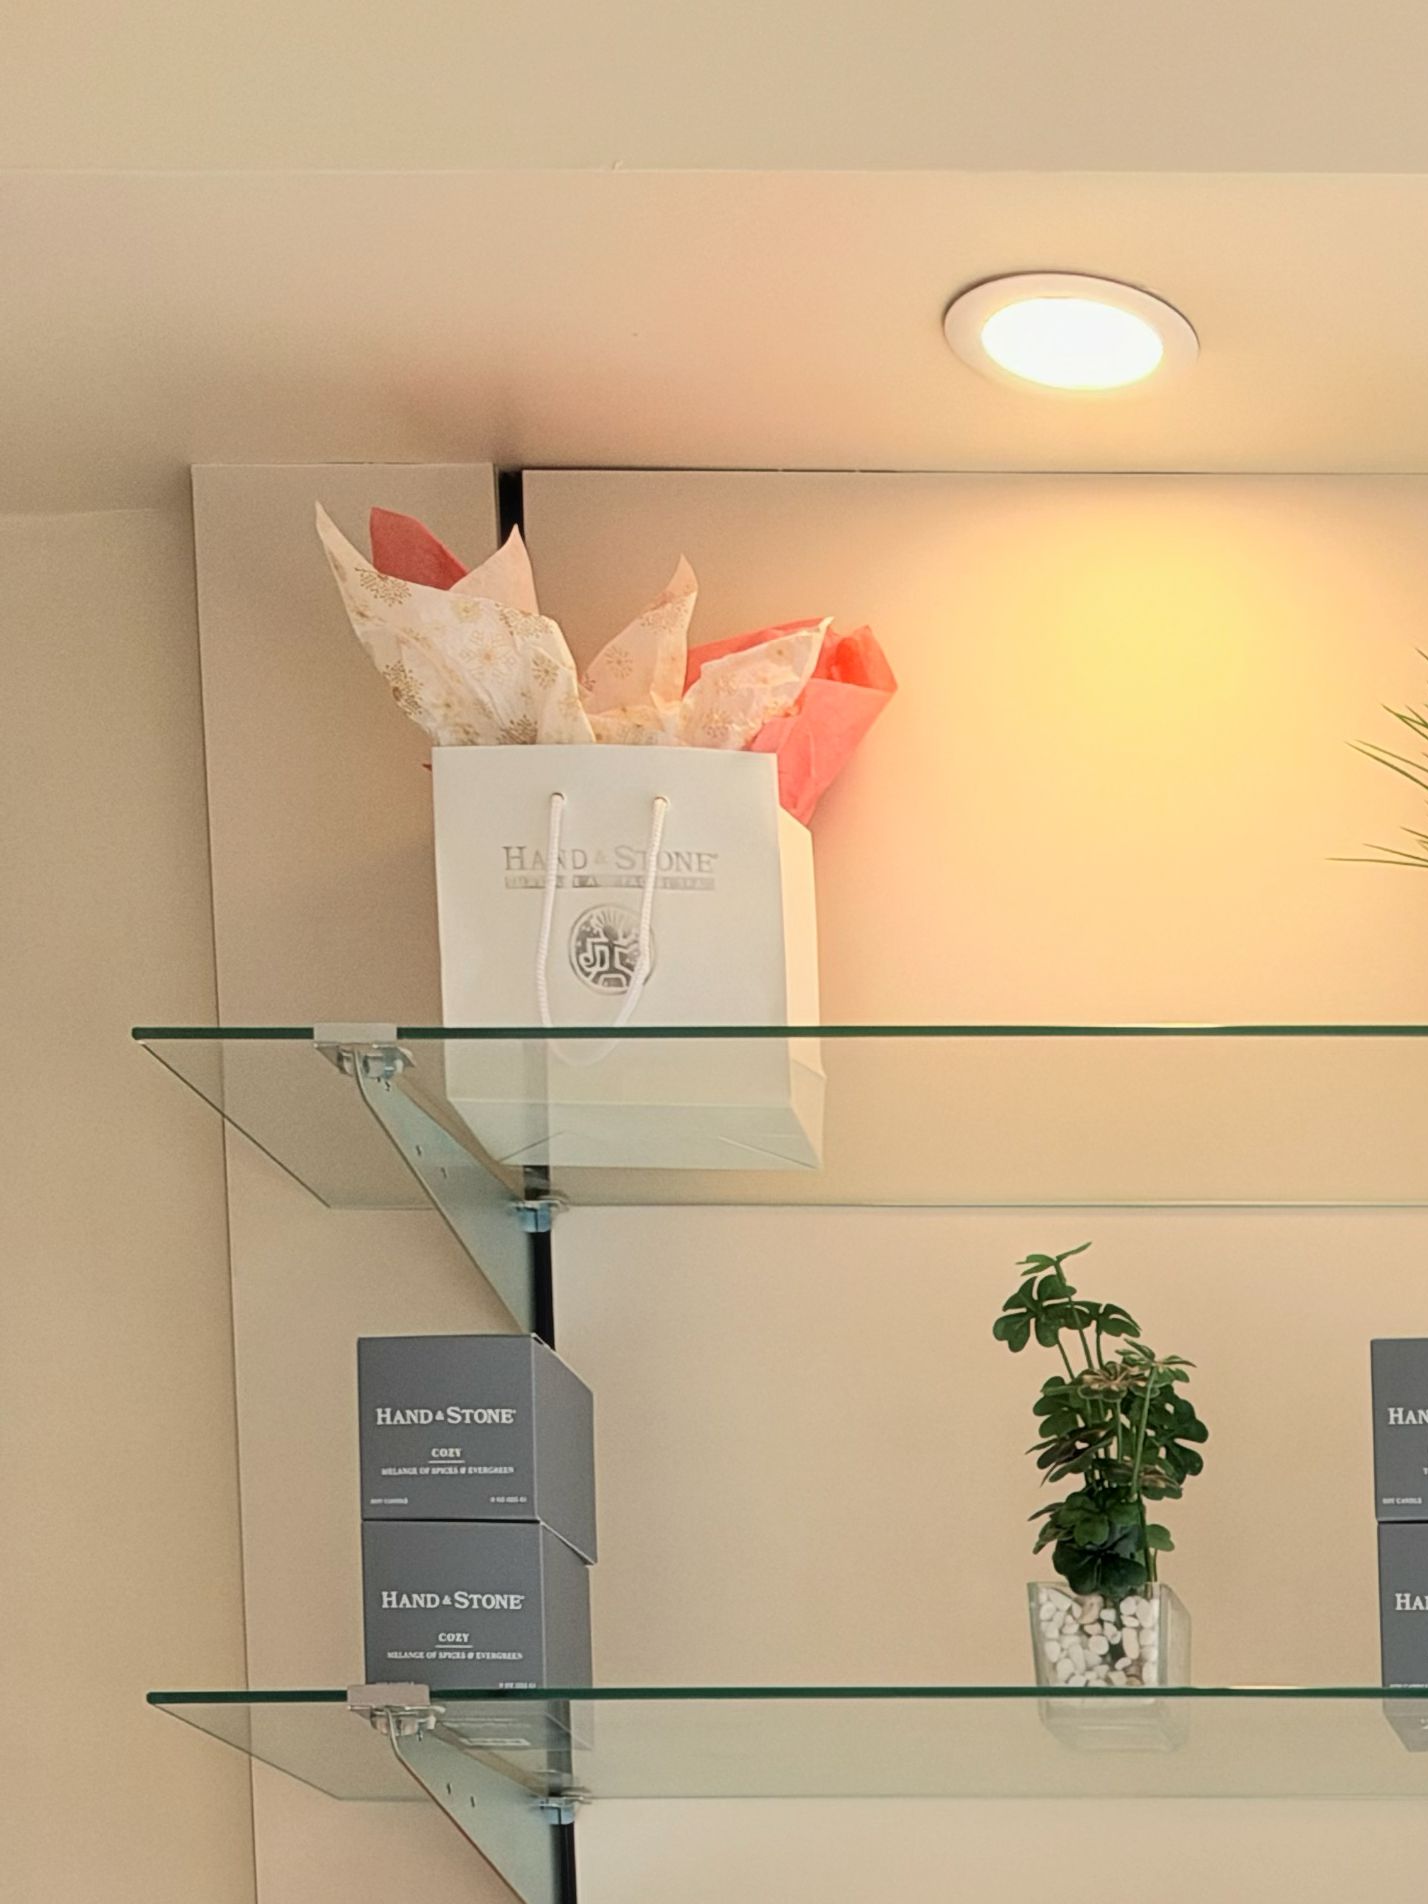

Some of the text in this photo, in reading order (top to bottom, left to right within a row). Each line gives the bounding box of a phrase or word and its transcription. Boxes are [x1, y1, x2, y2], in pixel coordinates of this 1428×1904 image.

[376, 1407, 514, 1425] HAND & STONE
[431, 1447, 462, 1458] COZY
